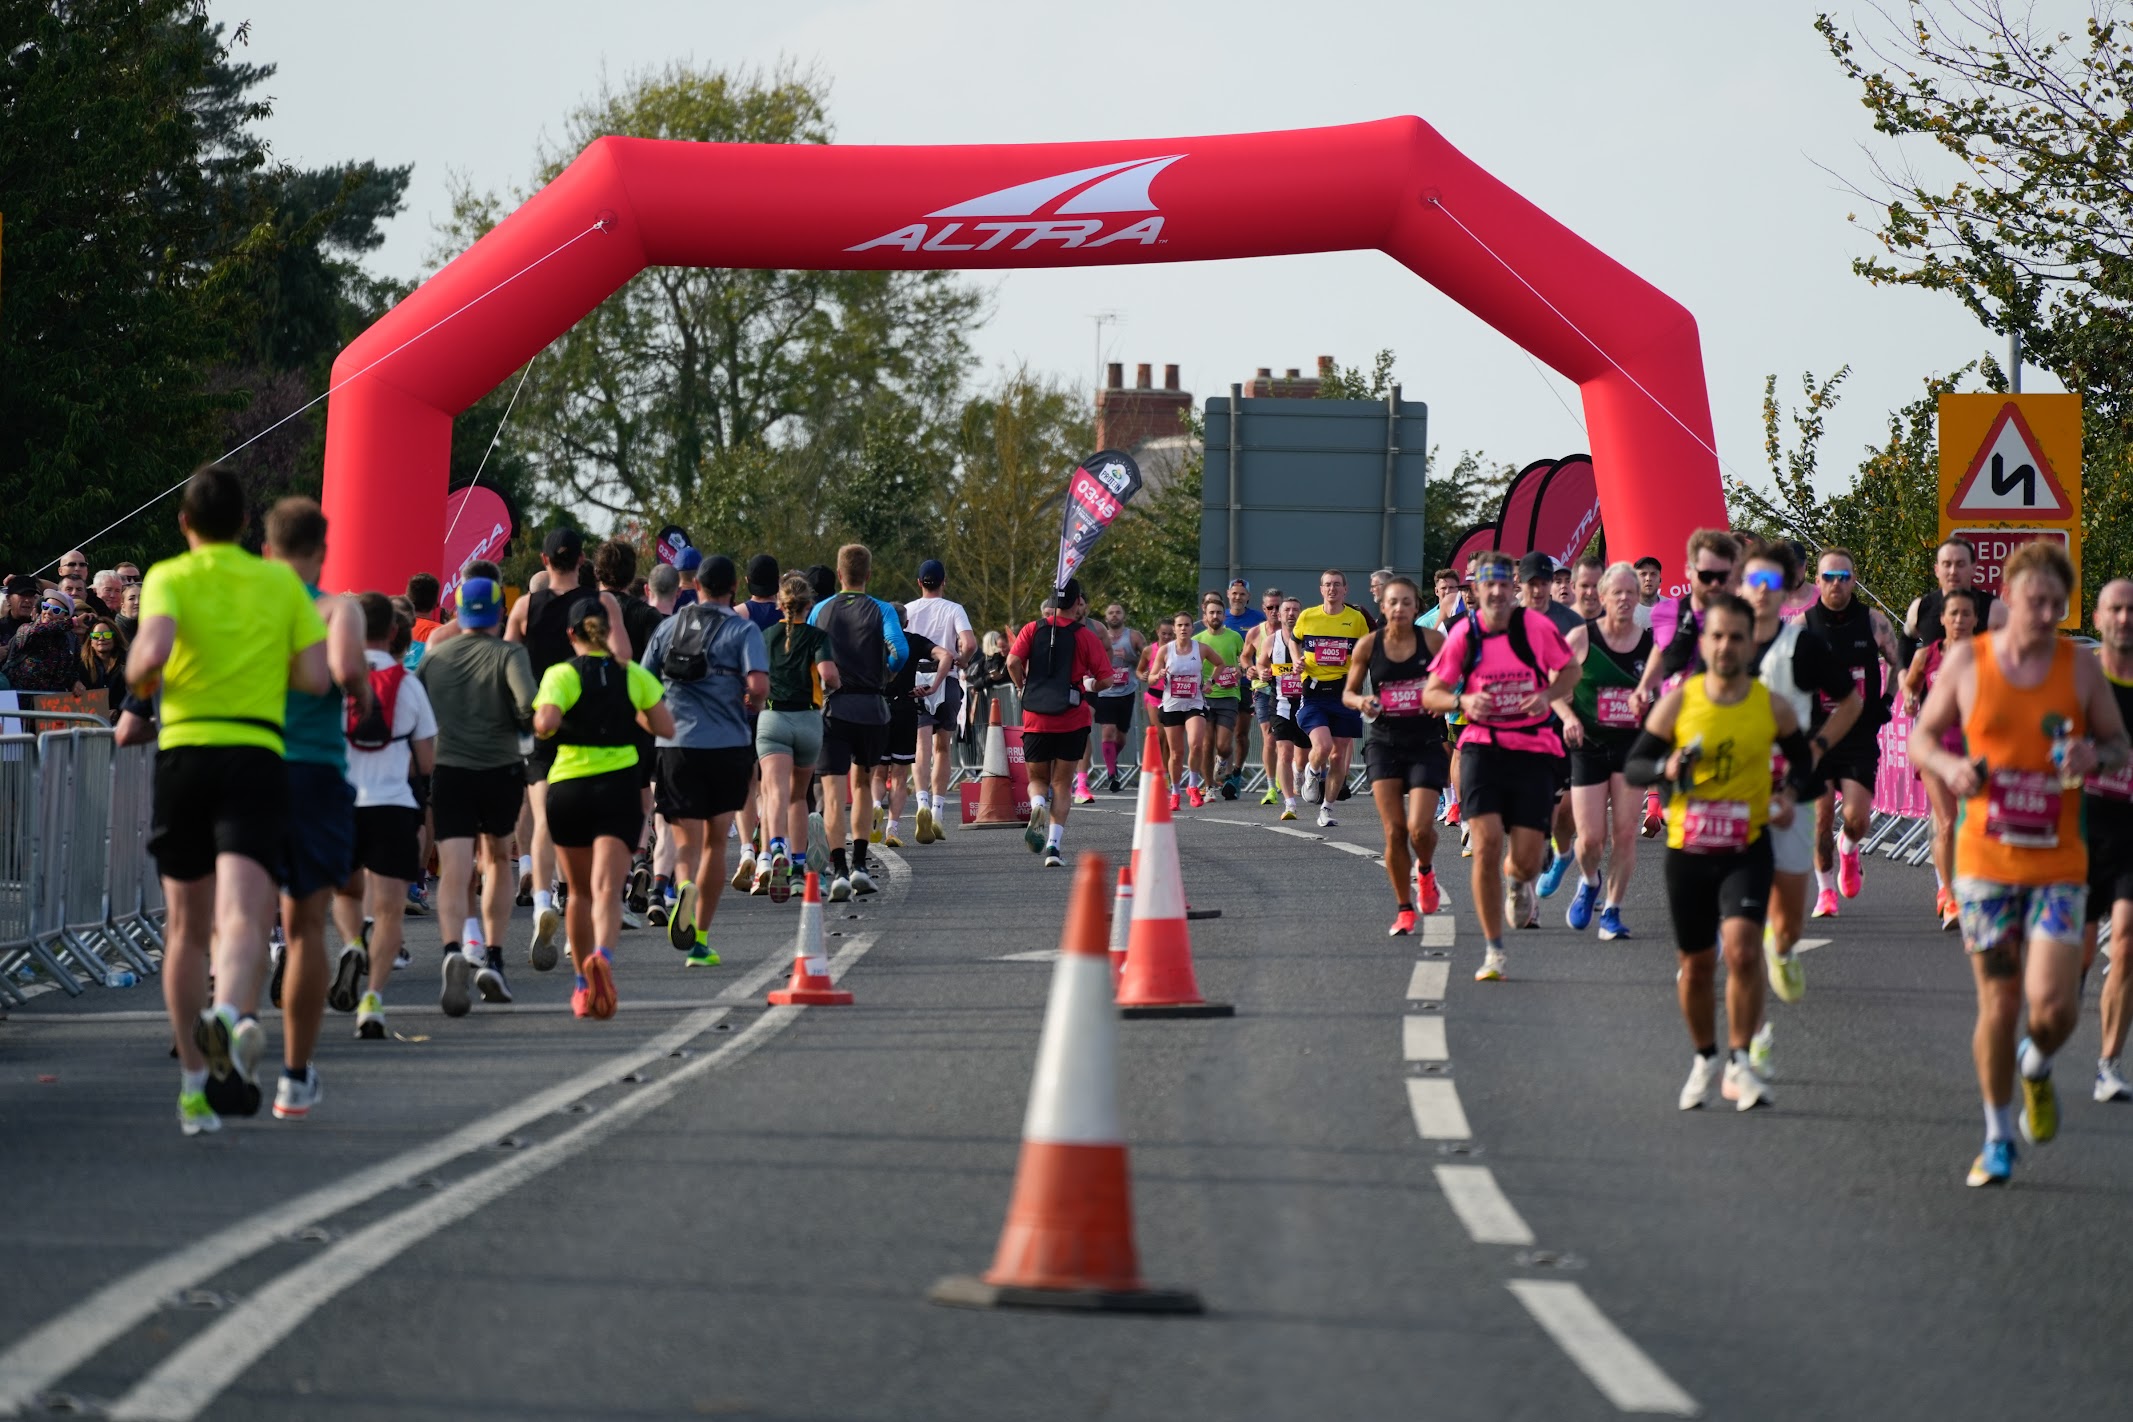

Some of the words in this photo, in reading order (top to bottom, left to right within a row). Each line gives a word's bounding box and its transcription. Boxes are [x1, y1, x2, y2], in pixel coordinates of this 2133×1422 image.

[842, 216, 1165, 252] ALTRA
[1101, 470, 1122, 492] PROTEIN
[1077, 479, 1116, 518] 03:45
[658, 544, 674, 564] 03:4
[1321, 648, 1340, 656] 4005
[1390, 691, 1417, 702] 3502
[1609, 701, 1633, 713] 596
